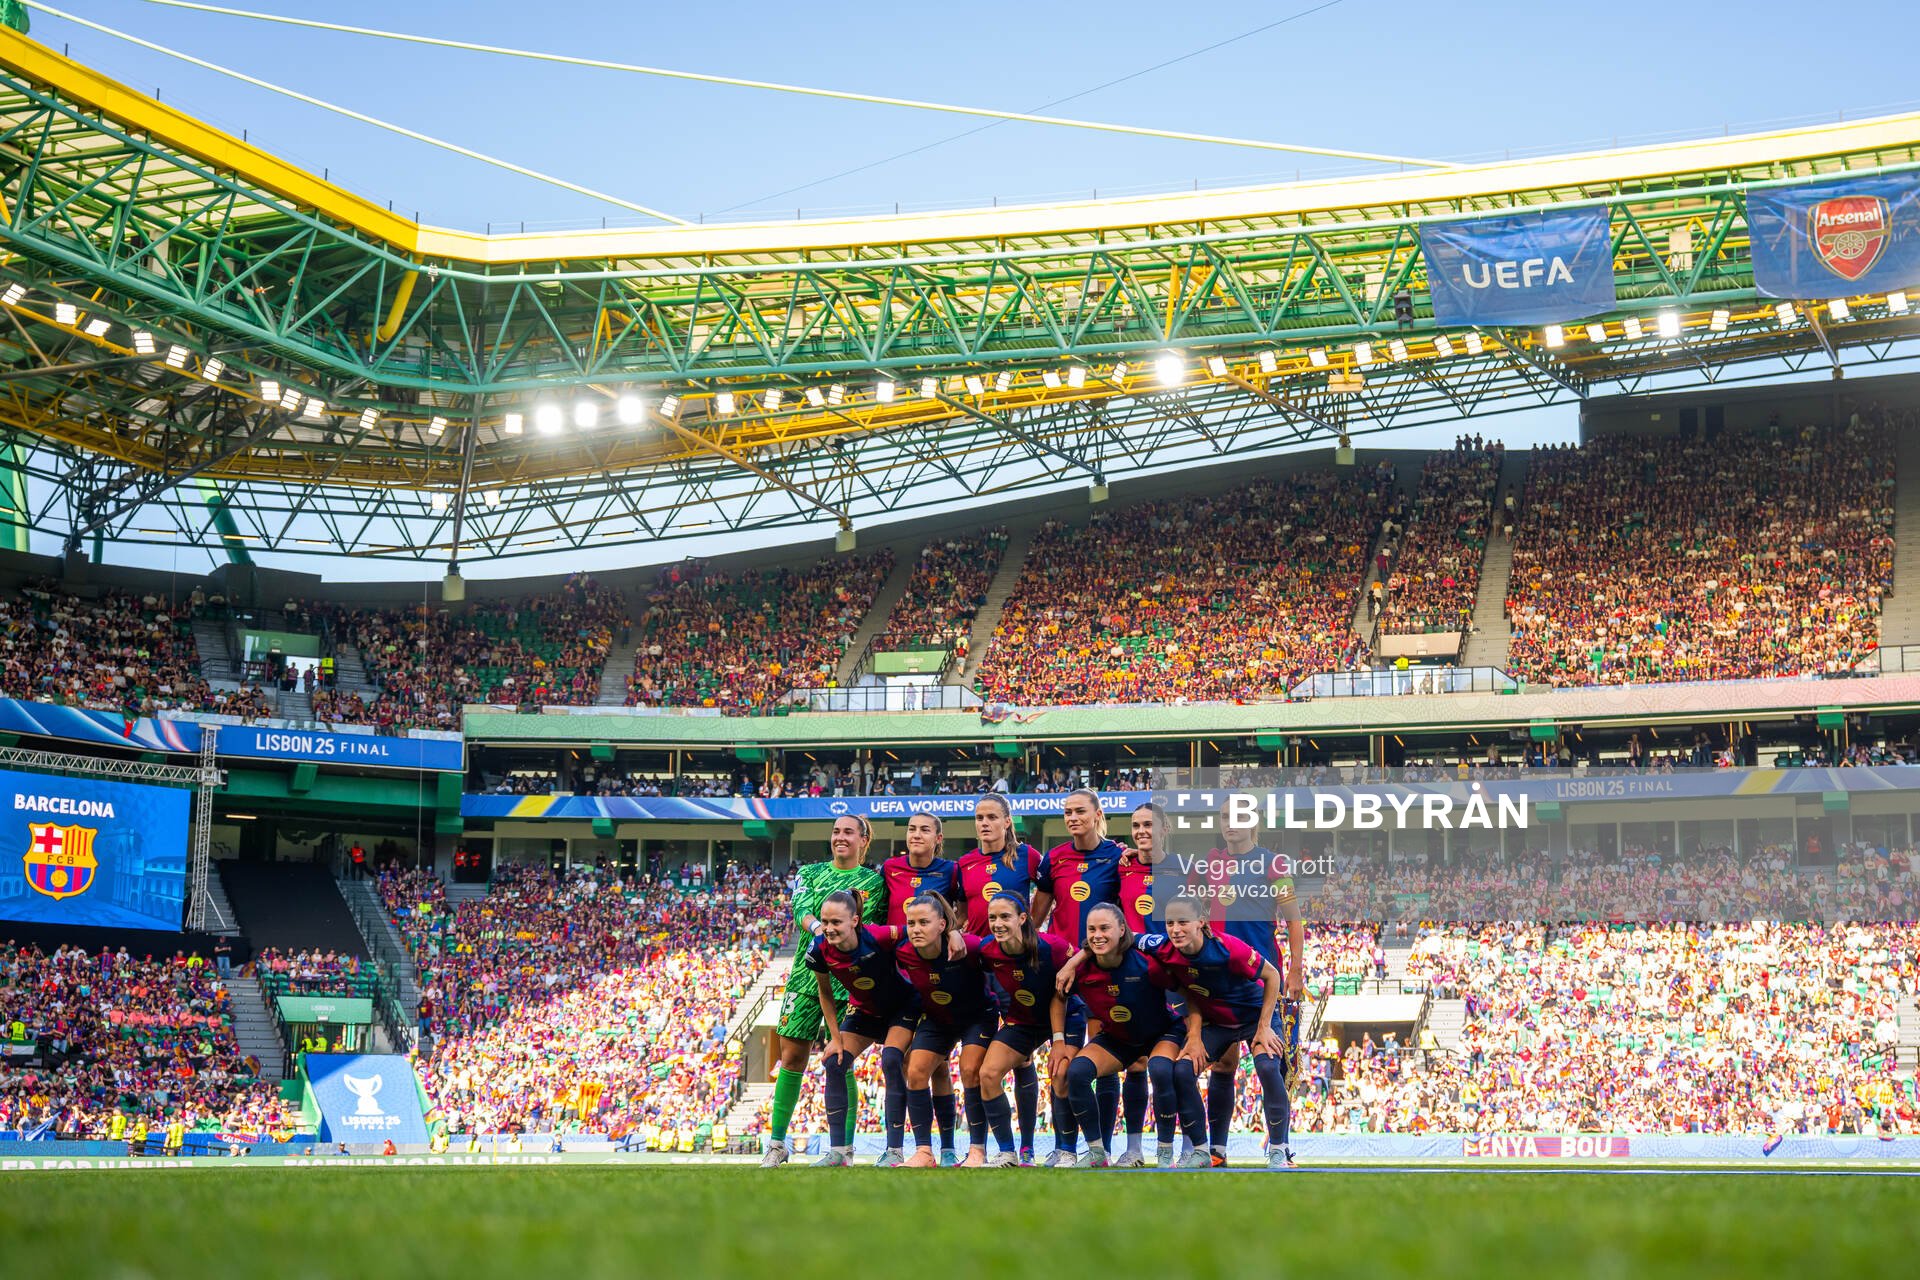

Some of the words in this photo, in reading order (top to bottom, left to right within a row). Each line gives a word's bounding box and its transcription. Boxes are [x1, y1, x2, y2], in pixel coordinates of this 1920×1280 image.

[1818, 207, 1880, 228] Arsenal
[1462, 256, 1576, 289] UEFA
[255, 733, 313, 753] LISBON
[314, 737, 336, 755] 25
[340, 741, 390, 756] FINAL
[1557, 781, 1605, 798] LISBON
[1607, 780, 1625, 796] 25
[1629, 780, 1674, 793] FINAL
[14, 793, 115, 818] BARCELONA
[870, 801, 905, 813] UEFA
[907, 799, 975, 812] WOMEN'S
[1008, 798, 1066, 811] AMPIONS
[1102, 796, 1127, 809] GUE
[47, 854, 75, 865] FCB
[341, 1115, 385, 1126] LISBON
[1560, 1136, 1613, 1158] BOU
